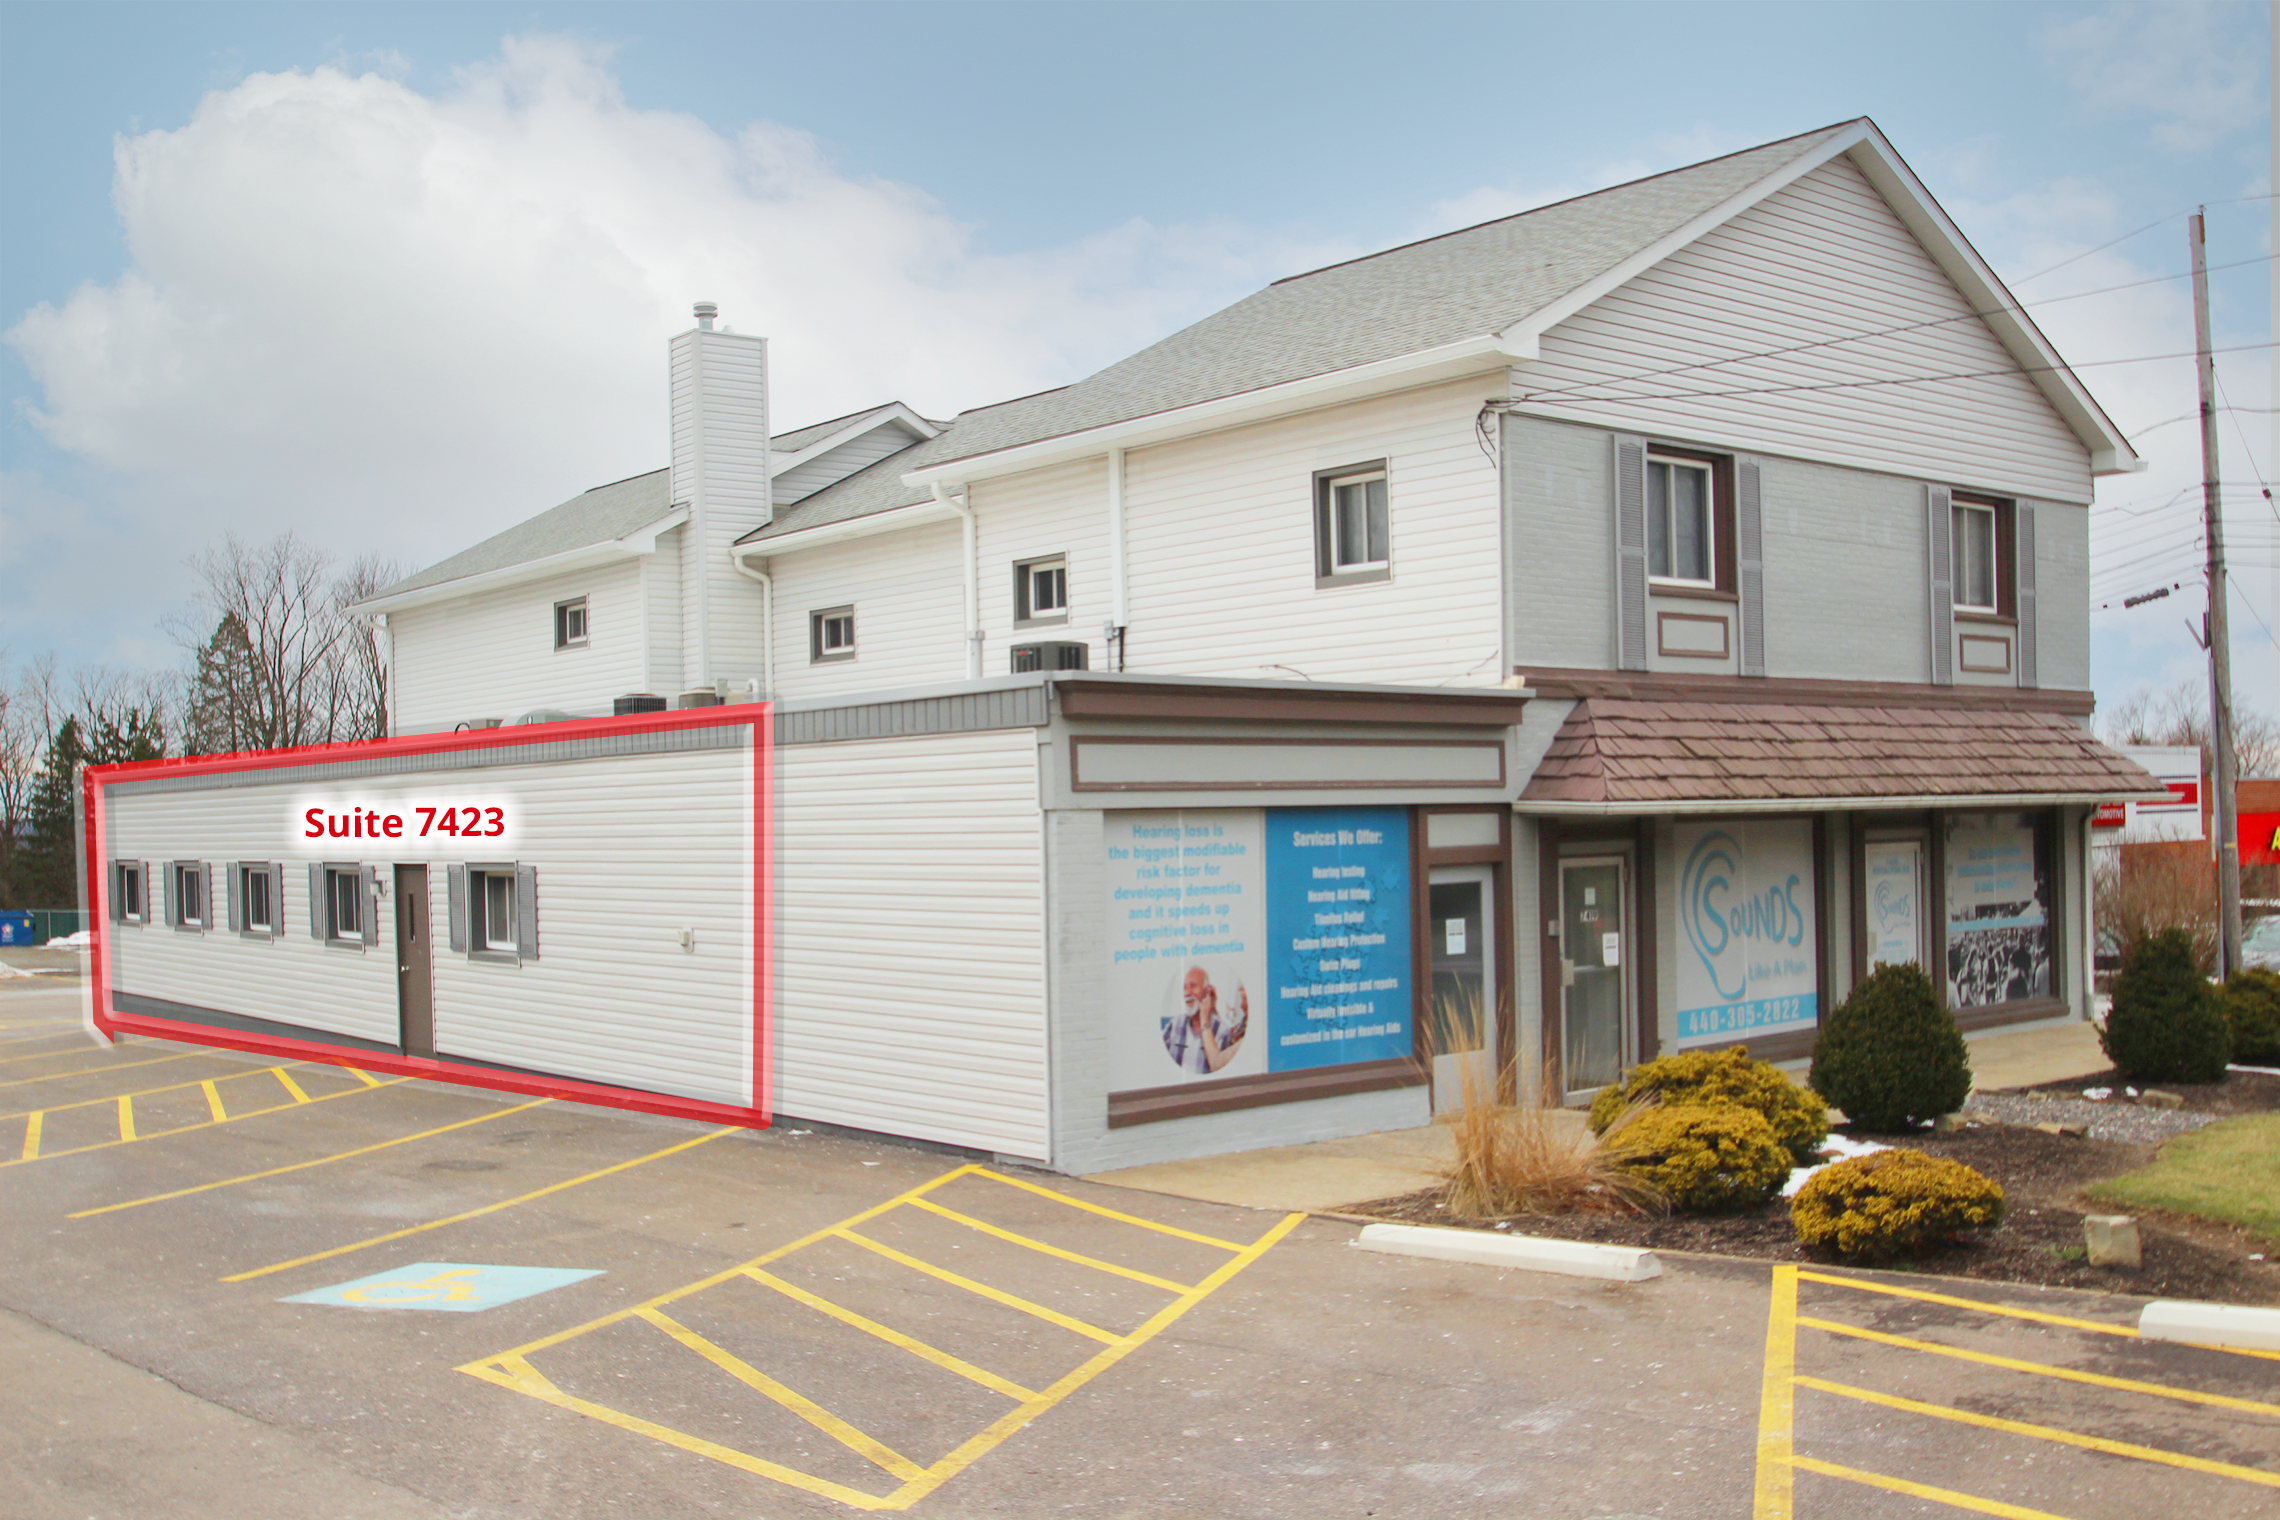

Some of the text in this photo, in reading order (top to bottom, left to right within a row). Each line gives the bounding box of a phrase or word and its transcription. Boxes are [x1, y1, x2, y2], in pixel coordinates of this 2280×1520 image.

[1132, 824, 1224, 841] Hearing loss is
[1293, 829, 1383, 847] Services We Offer:
[1108, 843, 1246, 862] the biggest modifiable
[1137, 862, 1221, 879] risk factor for
[1312, 866, 1340, 879] Hearing
[1114, 882, 1242, 901] developing dementia
[1307, 889, 1336, 903] Hearing
[1337, 888, 1348, 901] Aid
[1128, 903, 1230, 920] and it speeds up
[1129, 921, 1230, 942] cognitive loss in
[1292, 932, 1385, 951] Custom Hearing Protection
[1114, 940, 1245, 964] people with dementia
[1280, 986, 1309, 999] Hearing
[1310, 983, 1322, 996] Aid
[1359, 978, 1373, 991] and
[1368, 1001, 1374, 1014] &
[1689, 998, 1800, 1034] 440-305-2822
[1358, 1023, 1385, 1038] Hearing
